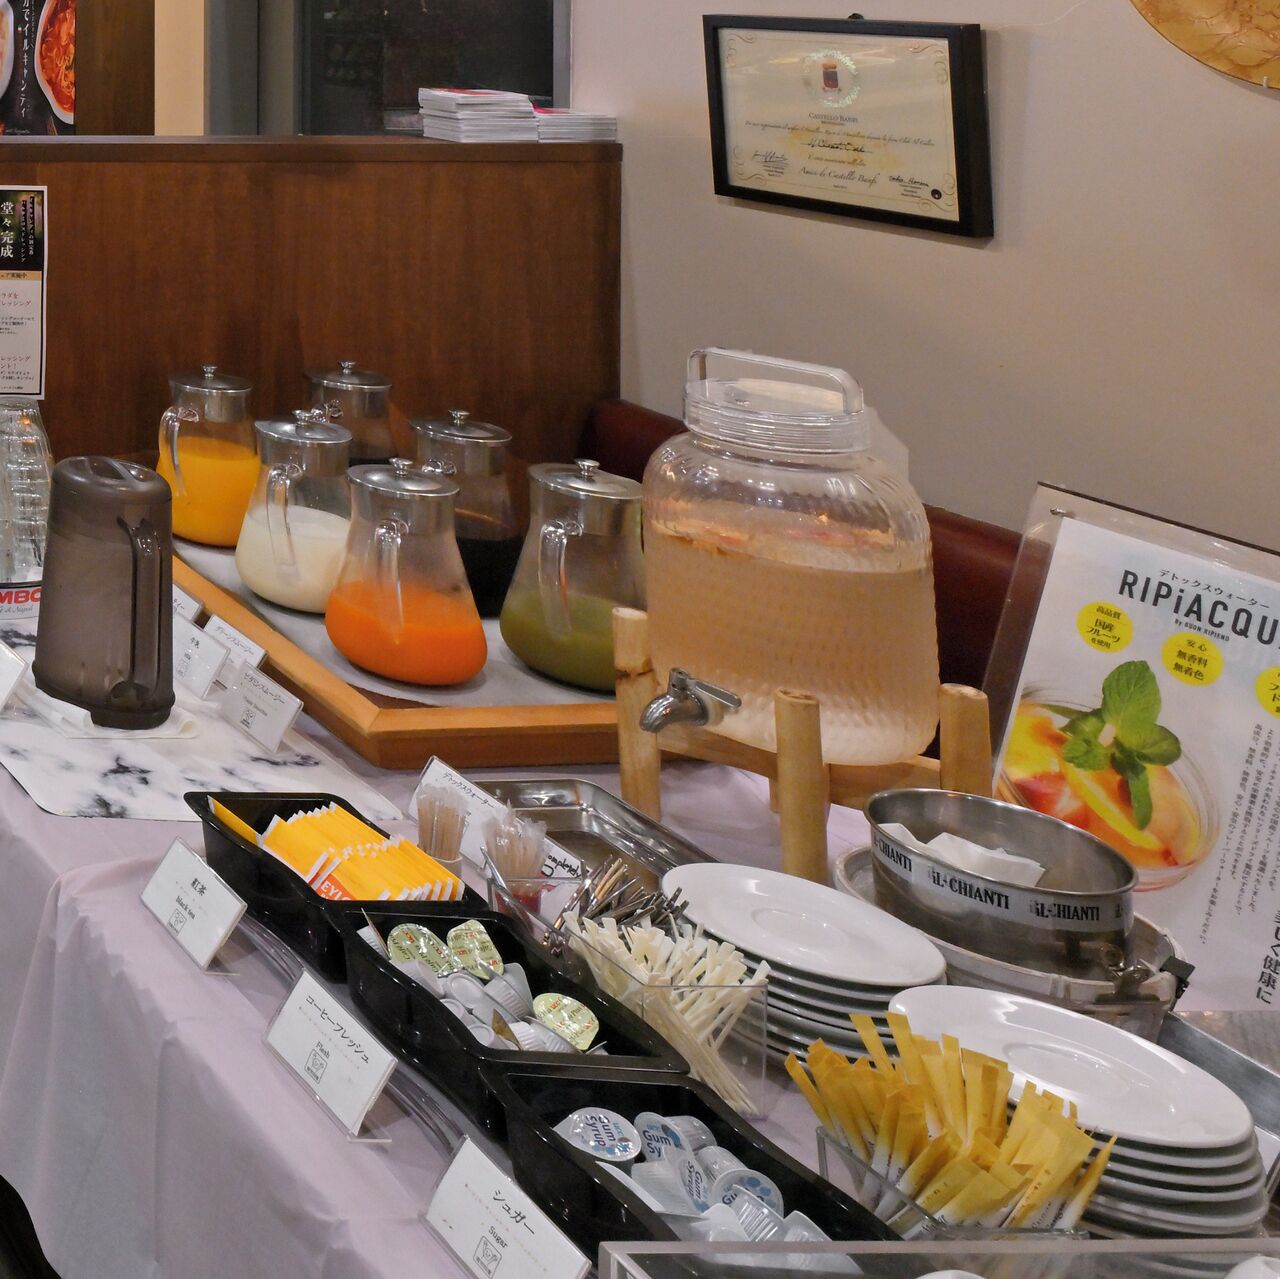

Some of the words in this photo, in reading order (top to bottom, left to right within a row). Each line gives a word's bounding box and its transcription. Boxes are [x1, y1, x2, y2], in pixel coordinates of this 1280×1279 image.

[0, 201, 14, 259] 堂々完成
[1159, 569, 1270, 610] デトックスウォーター
[1118, 569, 1280, 648] RIPiACQU
[1086, 627, 1121, 643] フルーツ
[1094, 618, 1115, 633] 国産
[1176, 649, 1209, 667] 無香料
[1172, 661, 1205, 681] 無着色
[191, 878, 207, 897] 紅茶
[176, 895, 189, 911] black
[306, 995, 369, 1064] コーヒーフレッシュ
[585, 1116, 607, 1147] Syrup
[600, 1115, 617, 1143] Gum
[642, 1130, 672, 1147] Gum
[493, 1190, 535, 1235] シュガー
[488, 1225, 509, 1249] Sugar
